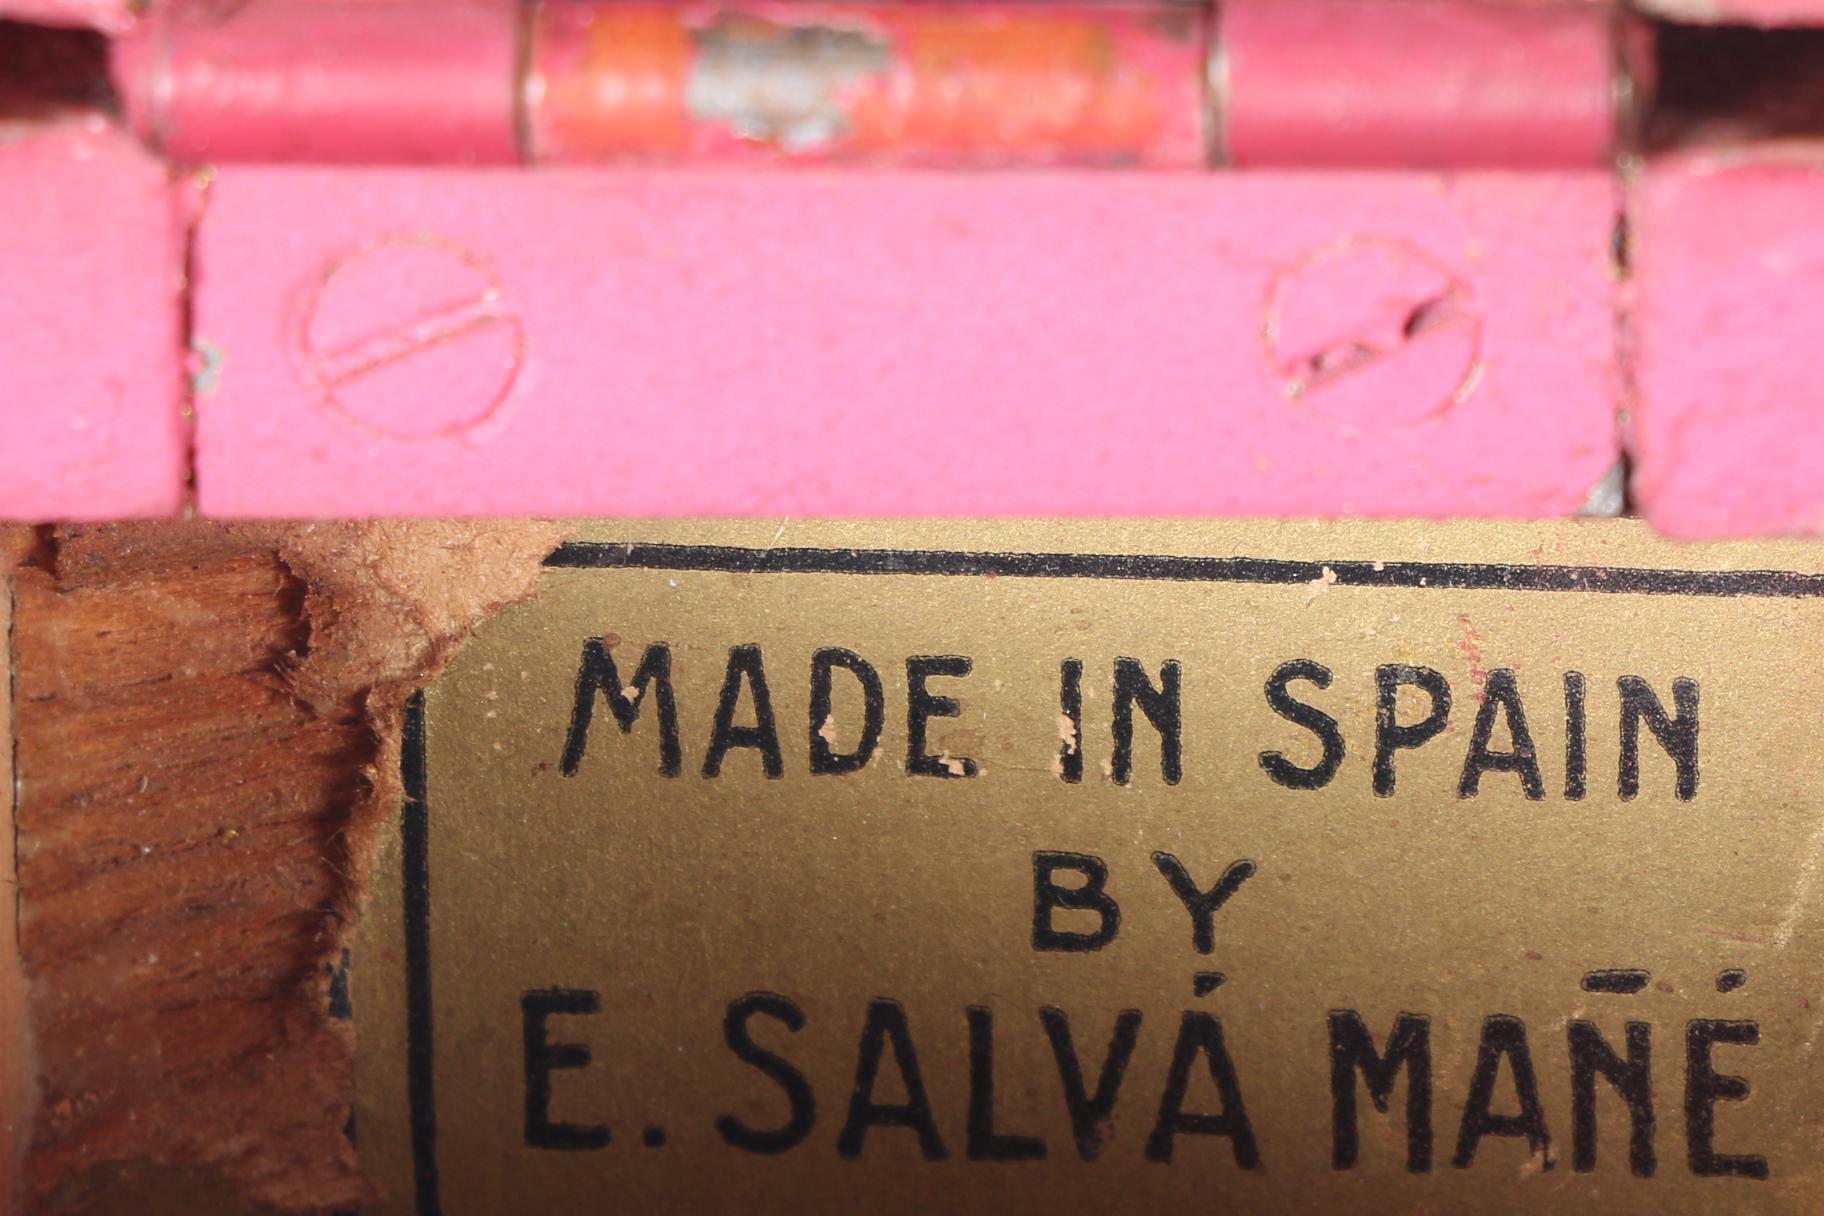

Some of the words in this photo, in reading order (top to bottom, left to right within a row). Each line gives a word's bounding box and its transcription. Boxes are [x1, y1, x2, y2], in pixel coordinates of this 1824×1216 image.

[559, 636, 977, 779] MADE
[1057, 657, 1183, 787] IN
[1258, 657, 1700, 802] SPAIN
[1032, 849, 1257, 955] BY
[518, 984, 669, 1152] E.
[714, 970, 1262, 1172] SALVÁ
